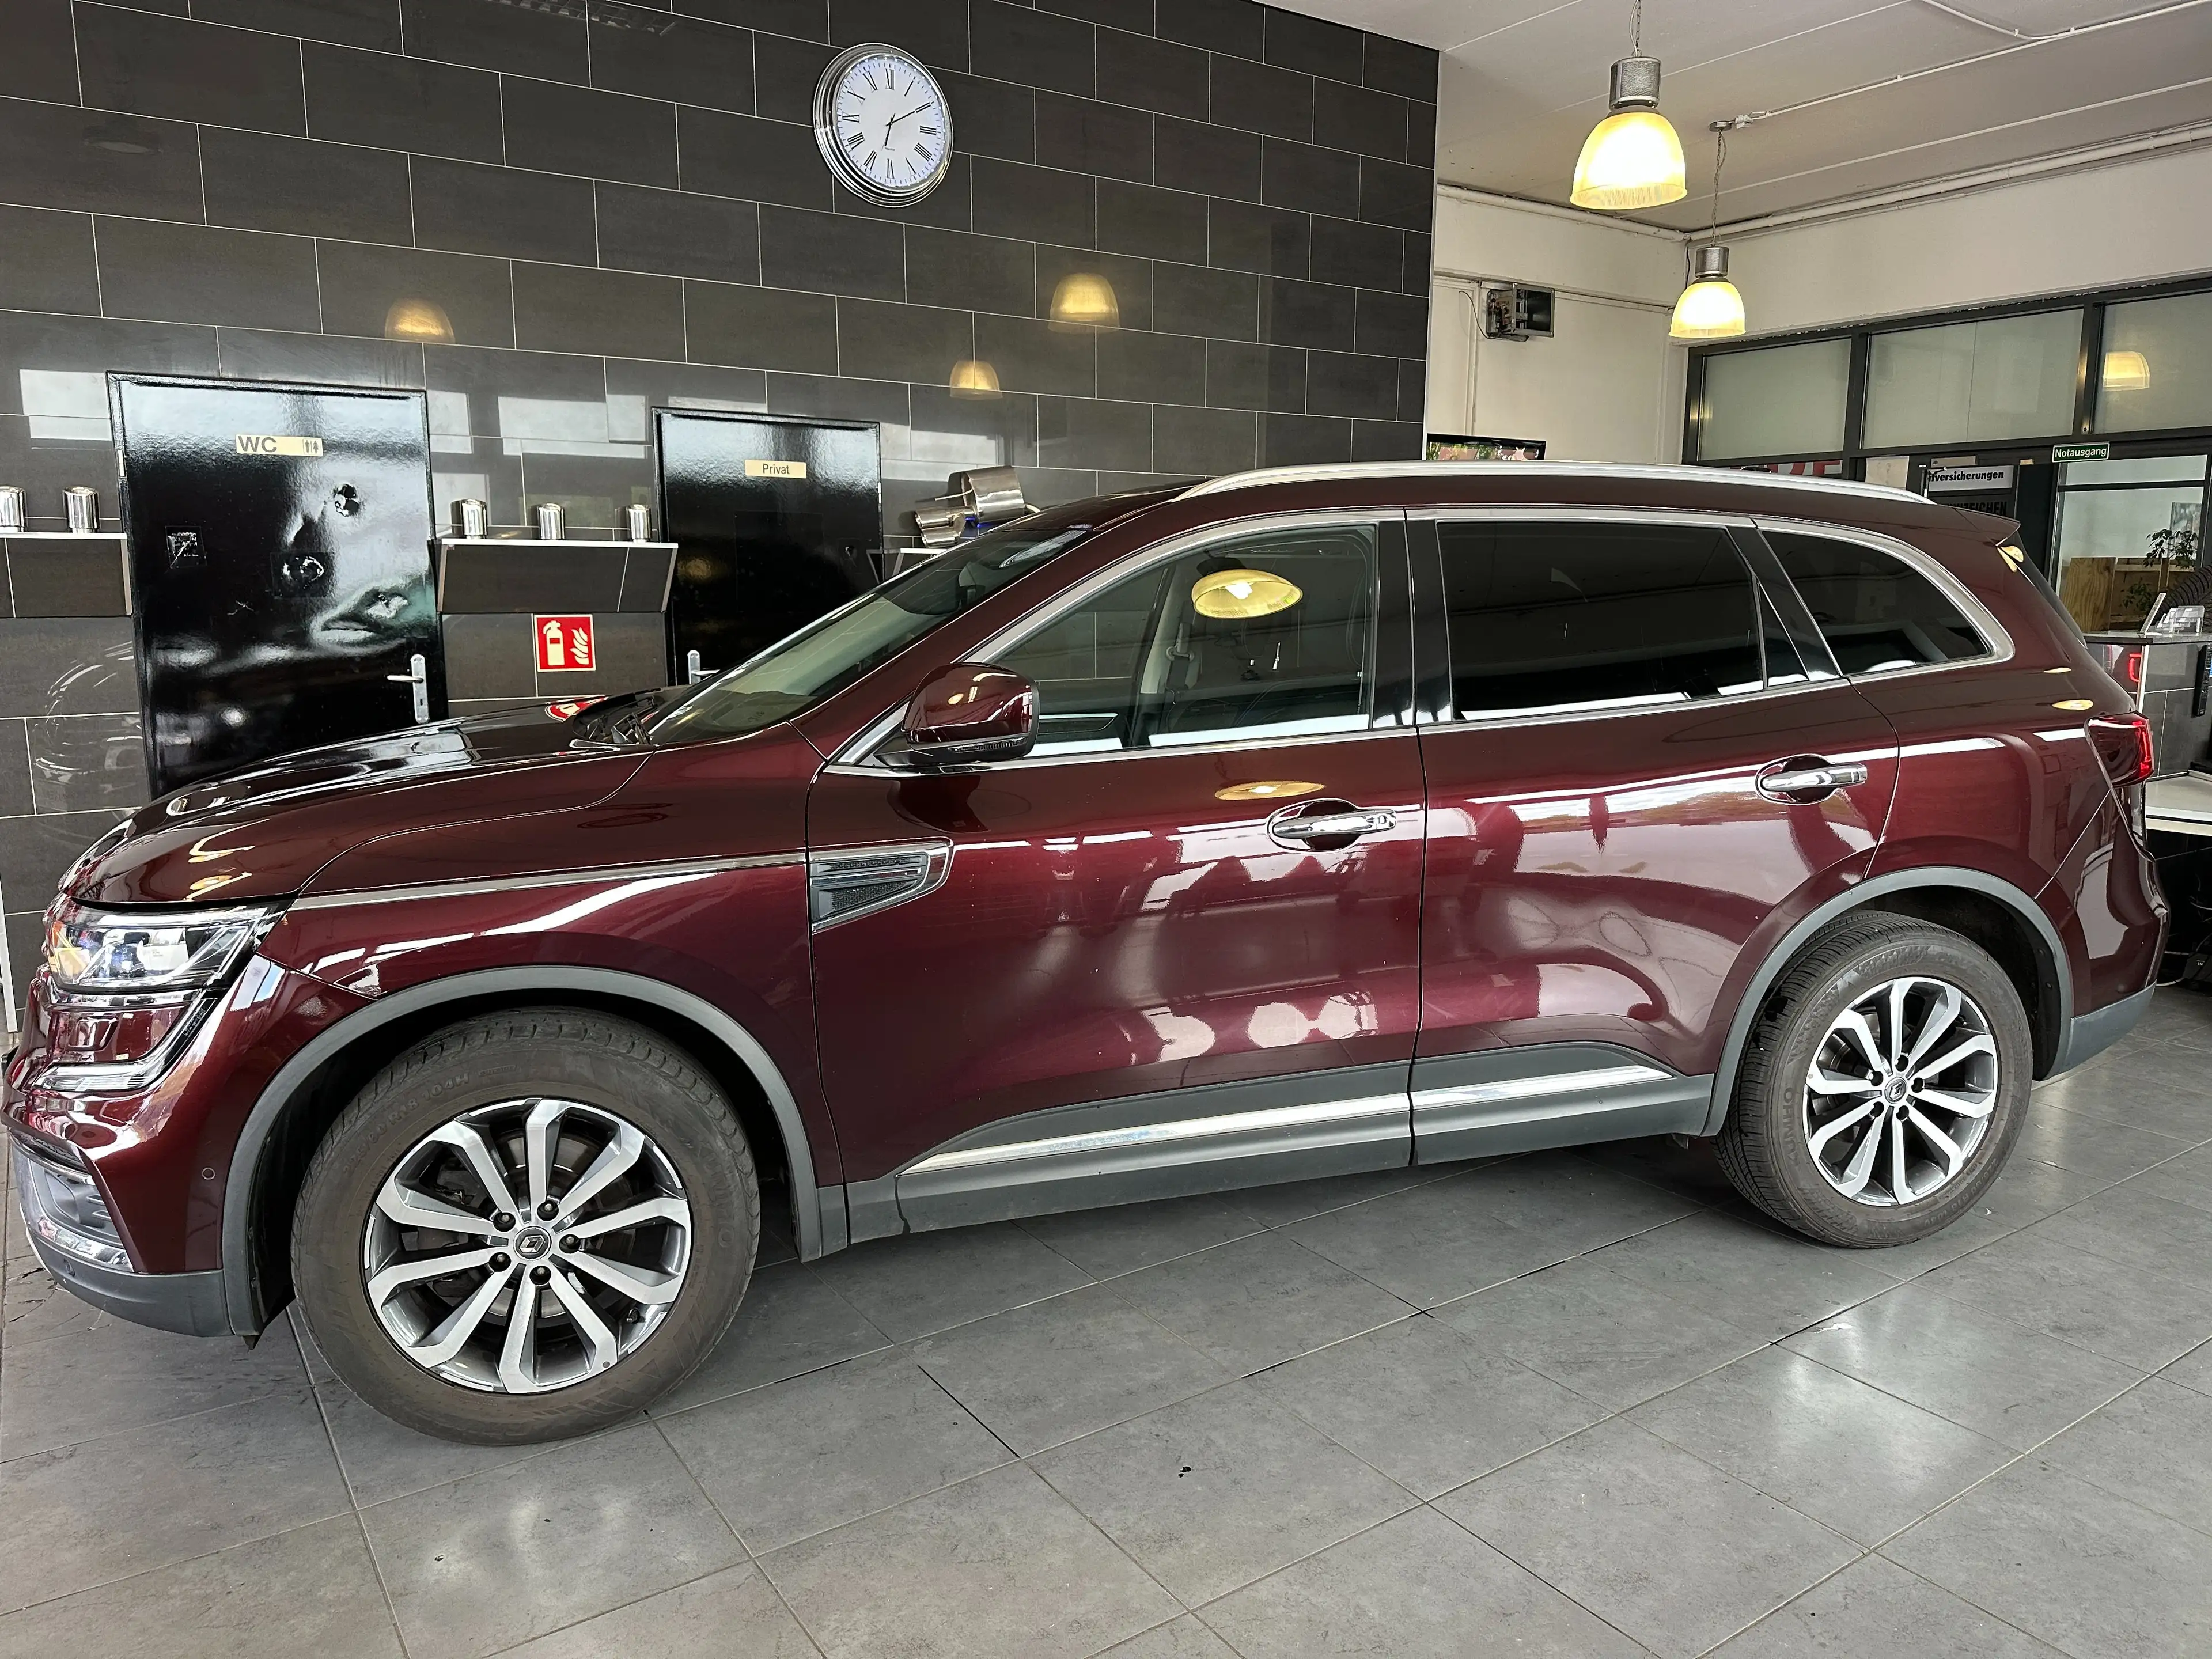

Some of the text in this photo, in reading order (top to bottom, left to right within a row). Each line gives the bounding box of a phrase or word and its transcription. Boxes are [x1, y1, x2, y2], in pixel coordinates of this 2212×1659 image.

[238, 435, 277, 453] WC
[2054, 447, 2107, 458] Notausgang
[762, 463, 790, 475] Privat
[423, 1073, 470, 1100] 104H
[1782, 1087, 1798, 1166] KUMHO
